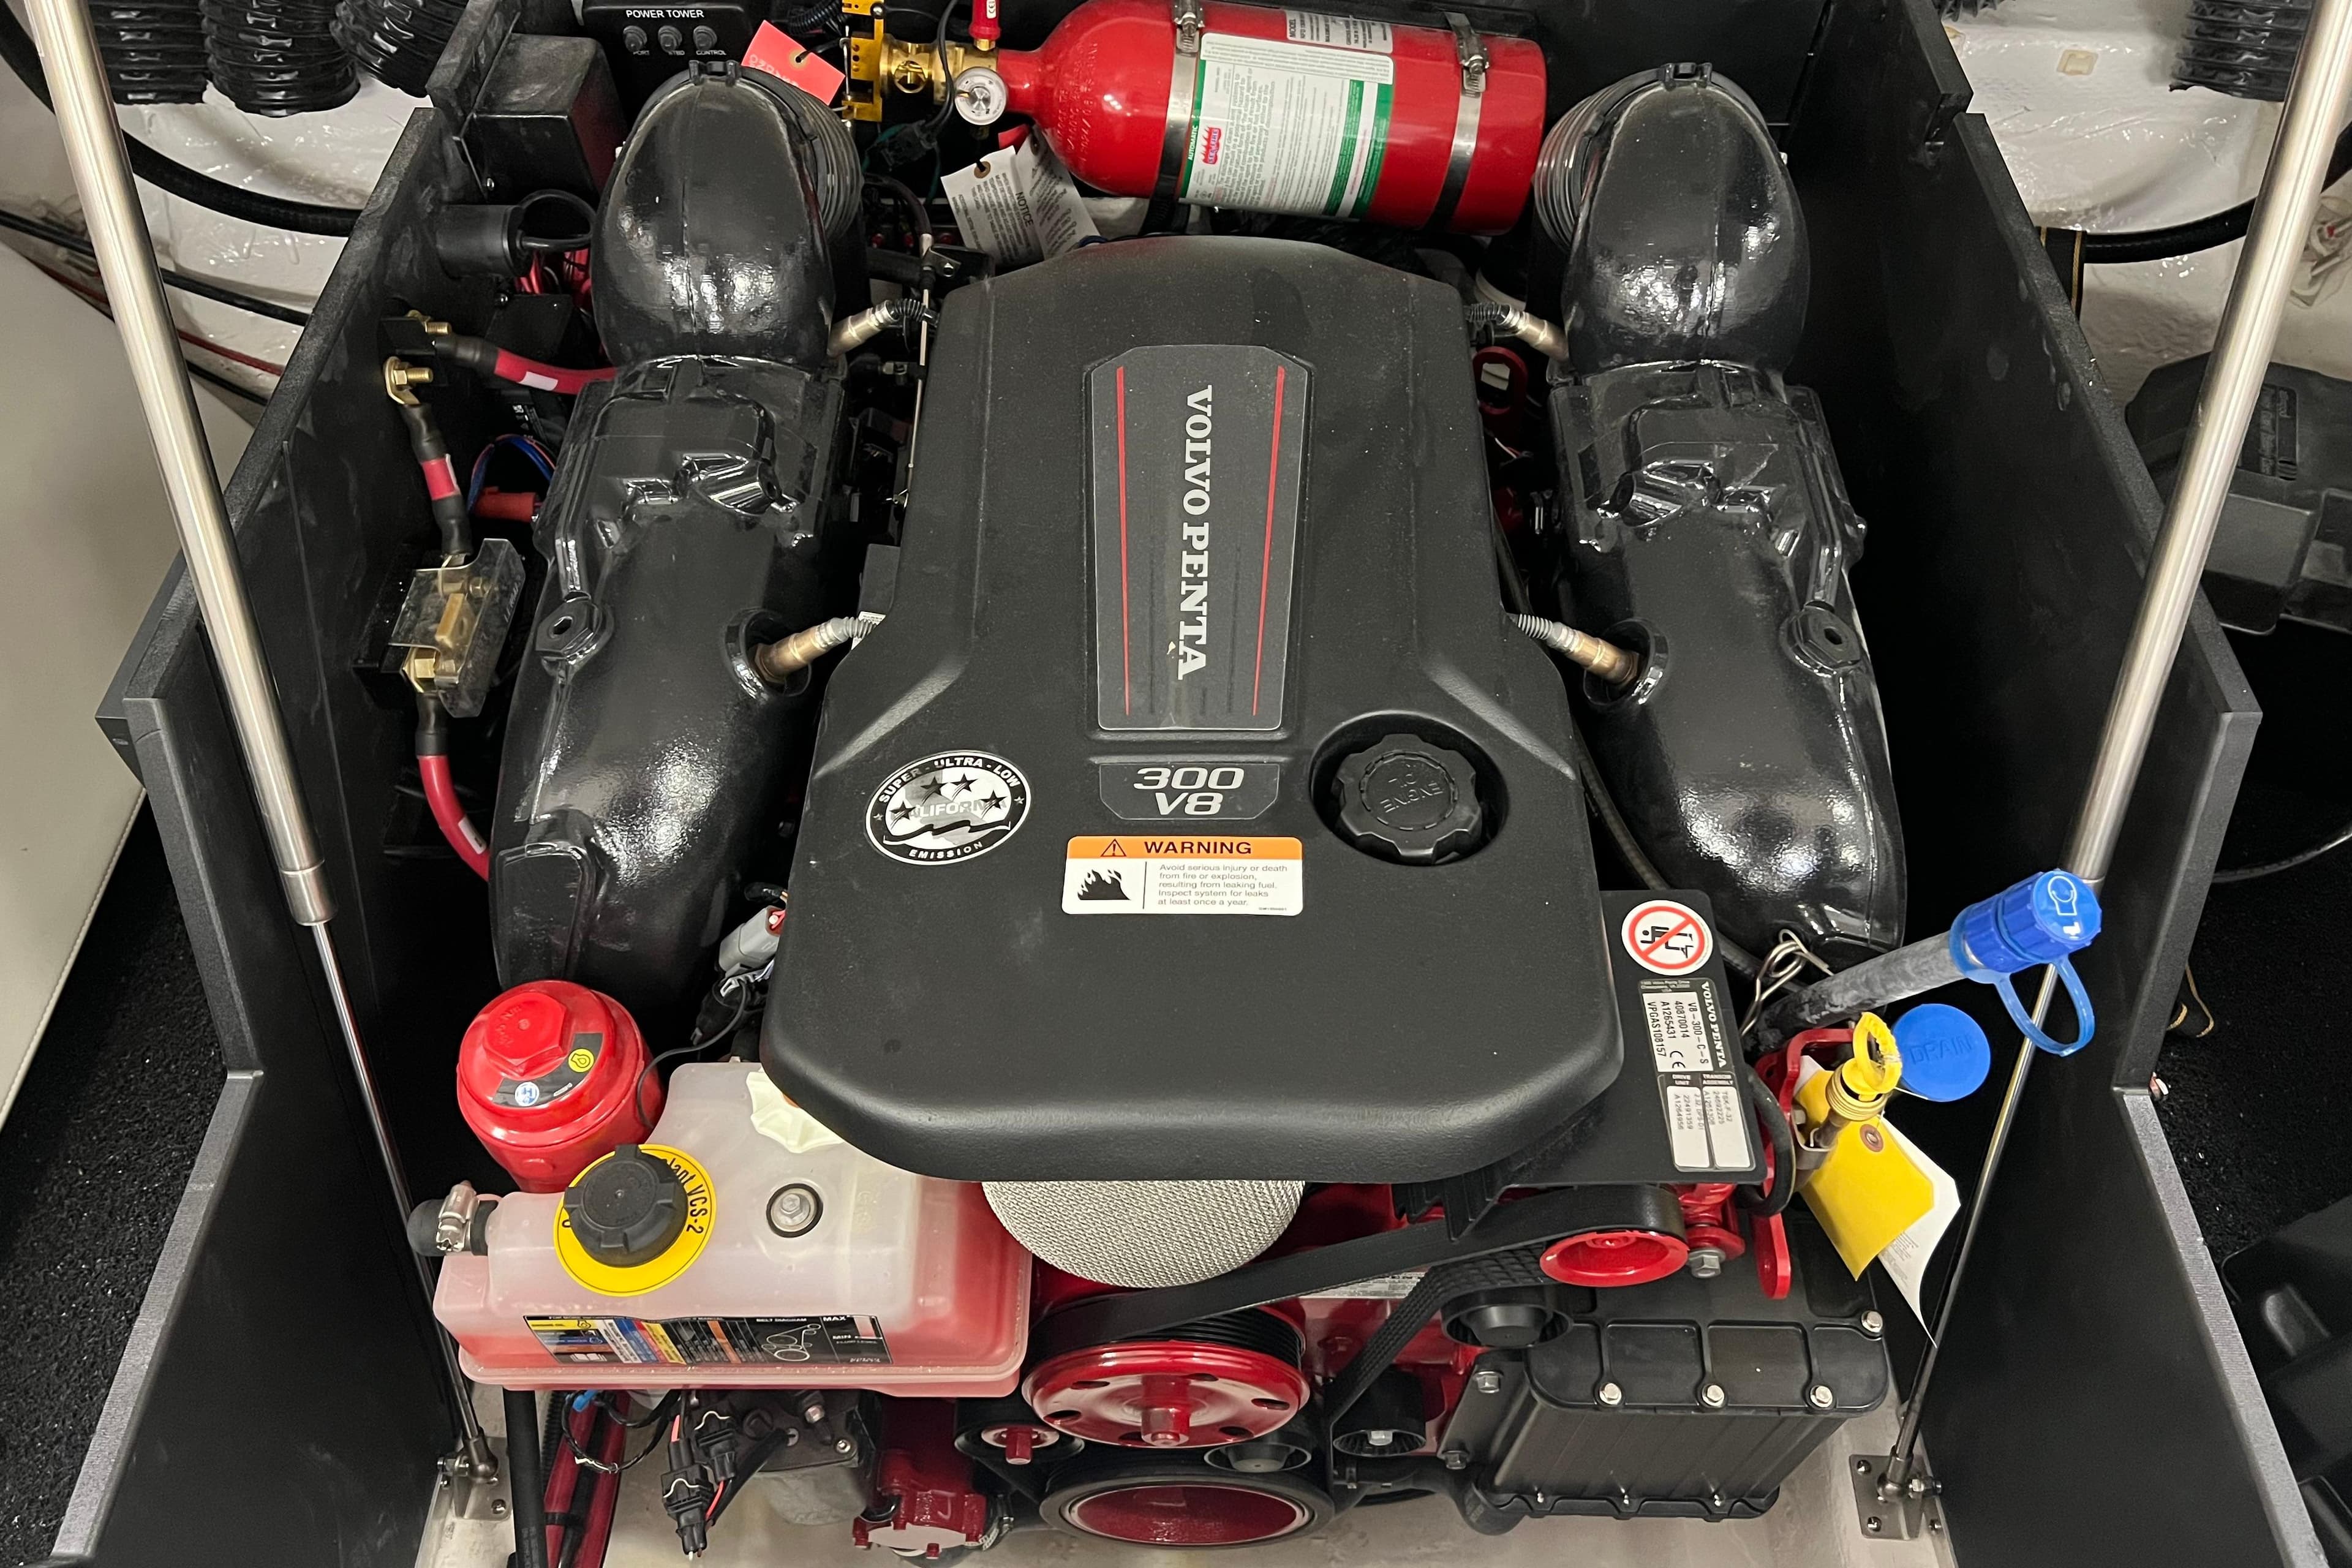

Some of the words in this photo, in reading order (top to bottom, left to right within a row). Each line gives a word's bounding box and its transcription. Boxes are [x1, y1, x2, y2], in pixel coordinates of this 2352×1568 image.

[626, 9, 665, 18] POWER
[666, 9, 705, 18] TOWER
[1187, 125, 1199, 161] AUTOMATIC
[1016, 191, 1033, 227] NOTICE
[1183, 384, 1213, 516] VOLVO
[1178, 522, 1210, 680] PENTA
[878, 767, 922, 804] SUPER
[934, 757, 983, 768] ULTRA
[993, 764, 1021, 787] LOW
[1133, 767, 1245, 790] 300
[890, 799, 1007, 821] ALIFORN
[1155, 792, 1224, 816] V8
[908, 841, 983, 859] EMISSION
[1144, 841, 1252, 854] WARNING
[1647, 1001, 1667, 1057] VPGAS108157
[1660, 1001, 1676, 1038] A1265431
[1675, 1001, 1690, 1038] 40870014
[1702, 981, 1717, 1022] VOLVO
[1710, 1023, 1727, 1068] PENTA
[1910, 1035, 1973, 1065] DRAIN
[686, 1184, 708, 1234] VCS-2
